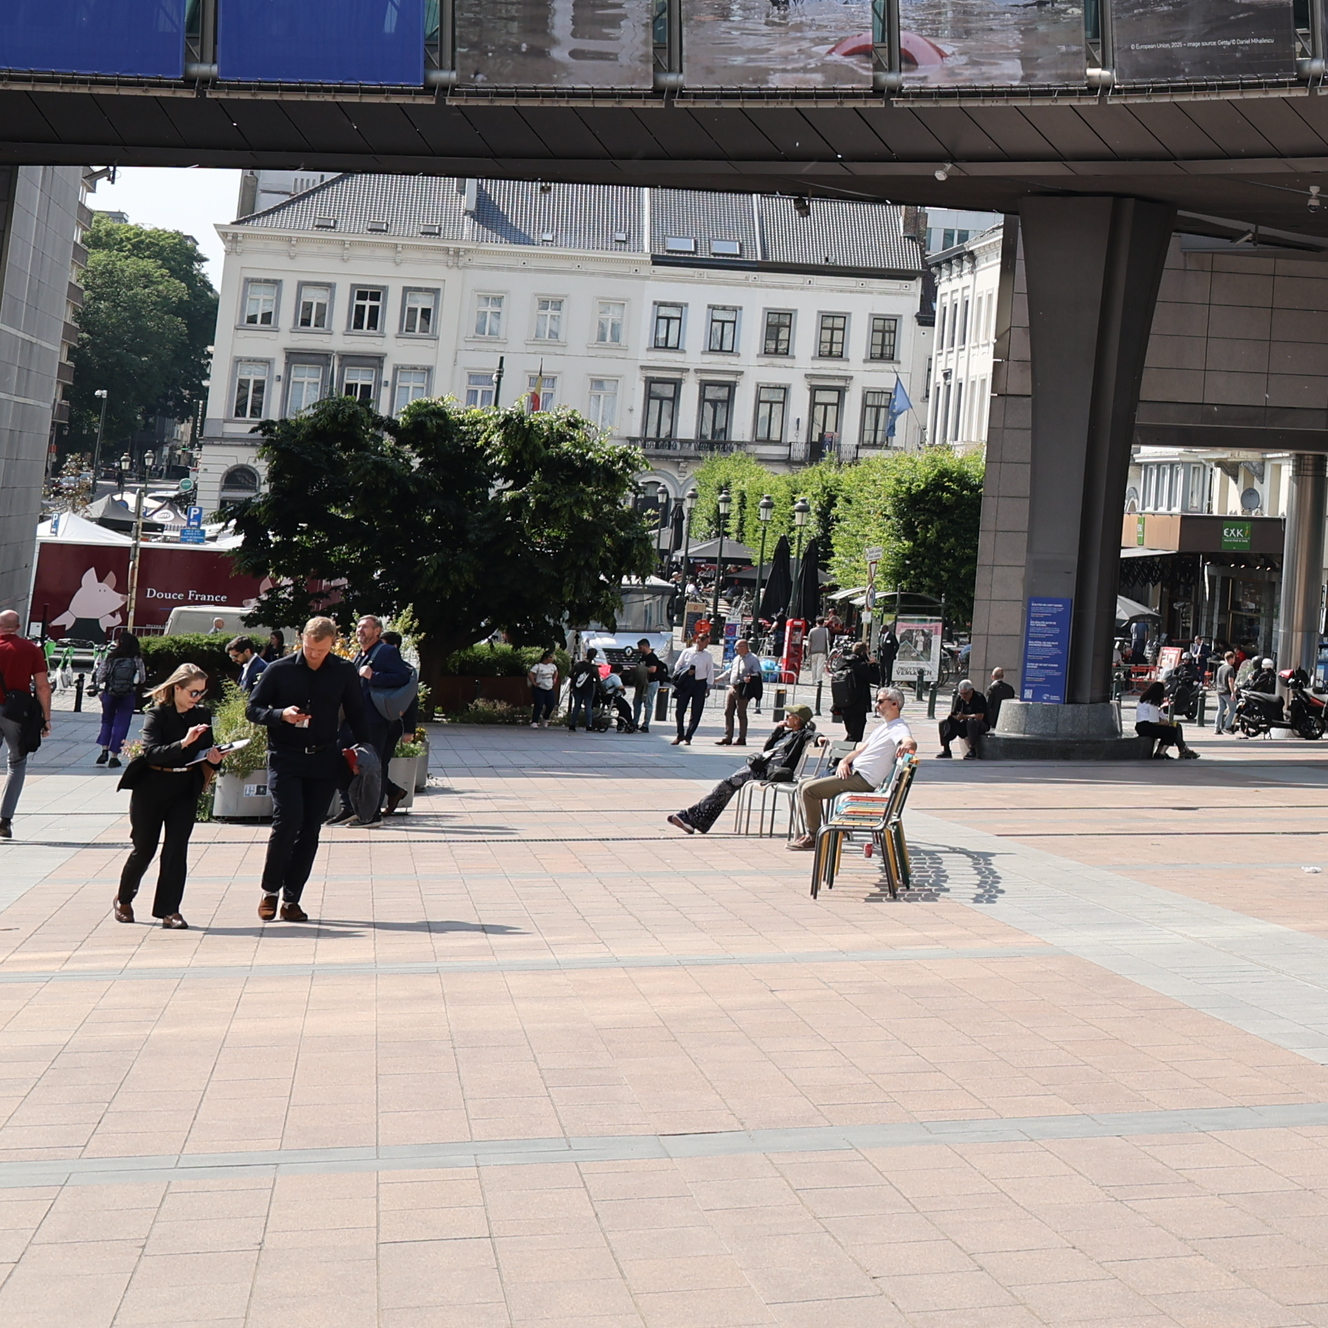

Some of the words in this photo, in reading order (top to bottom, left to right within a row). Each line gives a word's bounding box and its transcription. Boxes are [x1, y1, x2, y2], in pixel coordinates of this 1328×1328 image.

[190, 507, 200, 519] P
[146, 588, 184, 600] Douce
[188, 590, 228, 602] France
